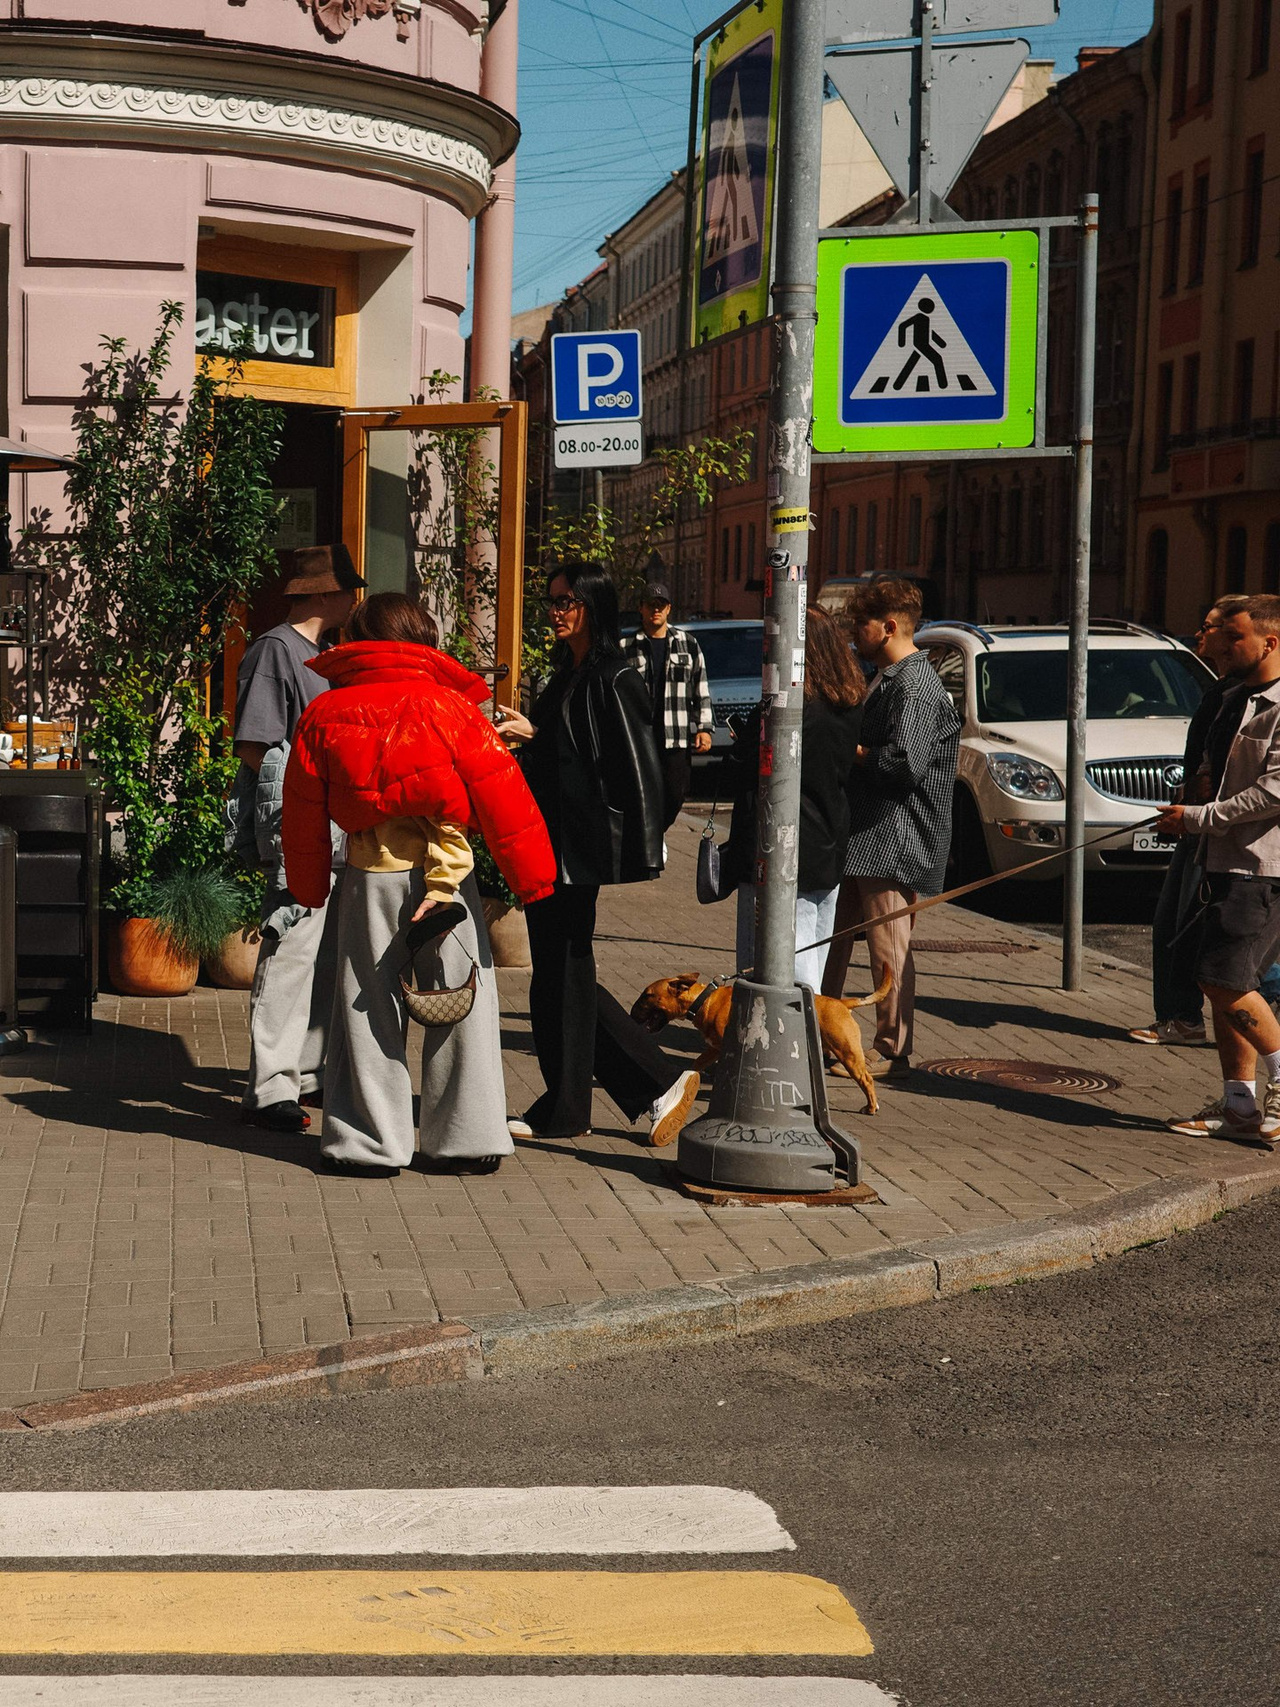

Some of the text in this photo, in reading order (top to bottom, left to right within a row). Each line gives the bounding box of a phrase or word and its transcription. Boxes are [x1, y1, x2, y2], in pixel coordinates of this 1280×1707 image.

[577, 343, 625, 412] P
[607, 396, 616, 405] 15
[618, 394, 632, 405] 20
[558, 437, 639, 454] 08.00-20.00
